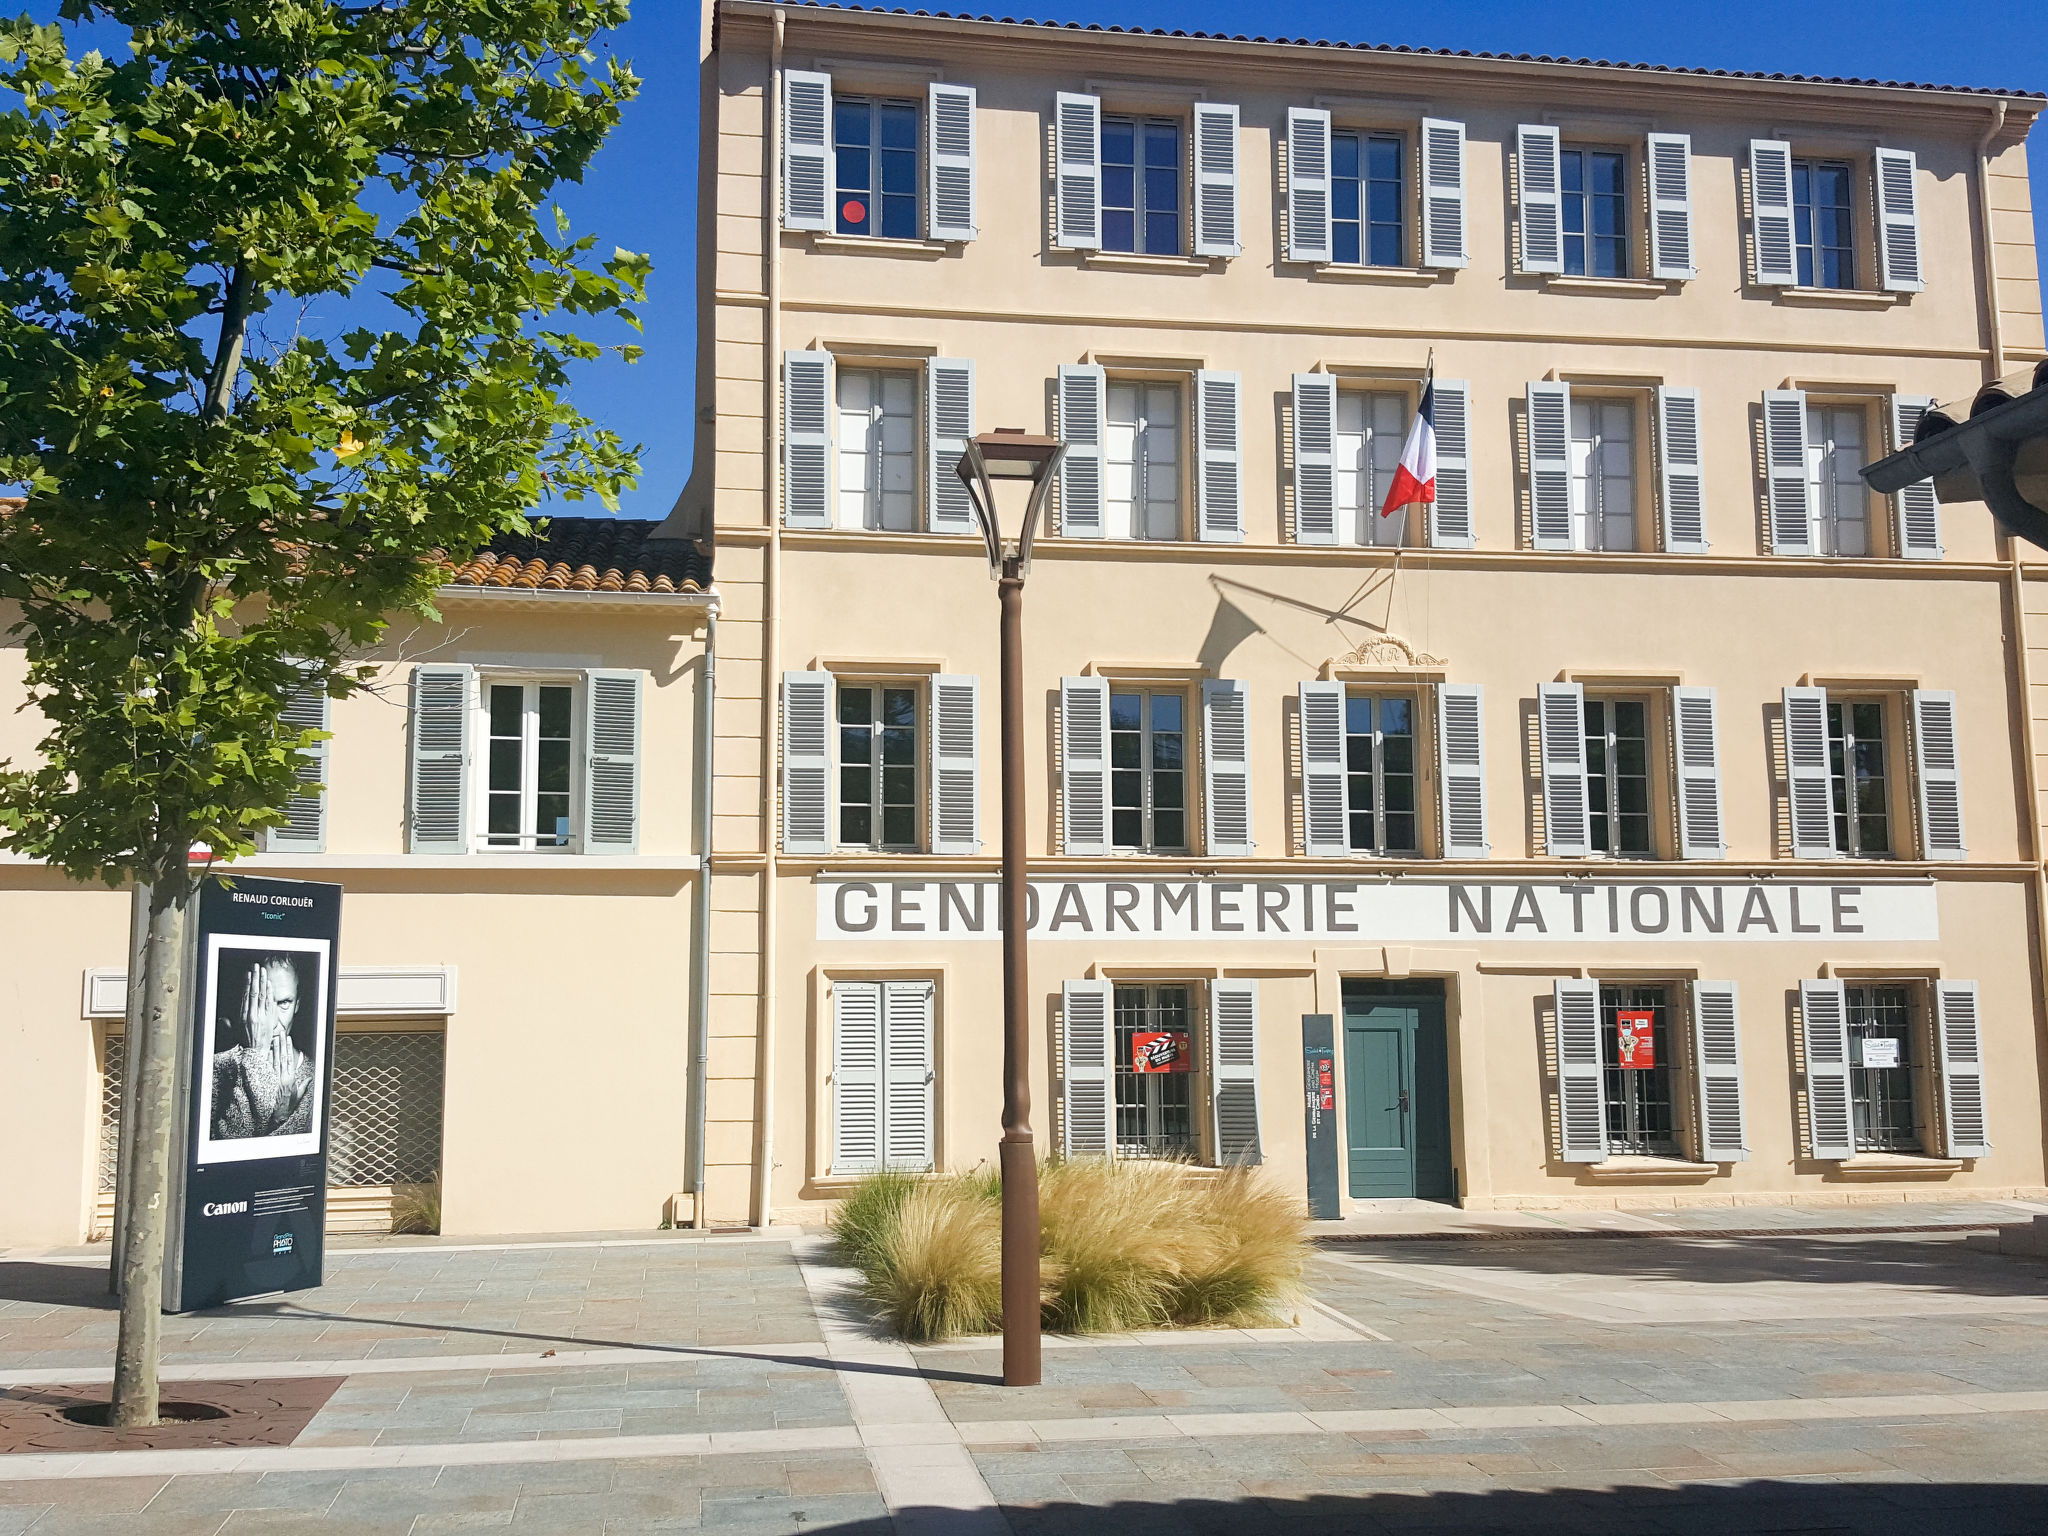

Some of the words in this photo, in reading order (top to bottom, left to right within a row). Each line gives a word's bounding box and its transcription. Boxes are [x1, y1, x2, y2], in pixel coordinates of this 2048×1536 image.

[232, 892, 268, 904] RENAUD
[834, 882, 1359, 933] GENDARMERIE
[1448, 885, 1864, 934] NATIONALE
[203, 1200, 248, 1217] Canon
